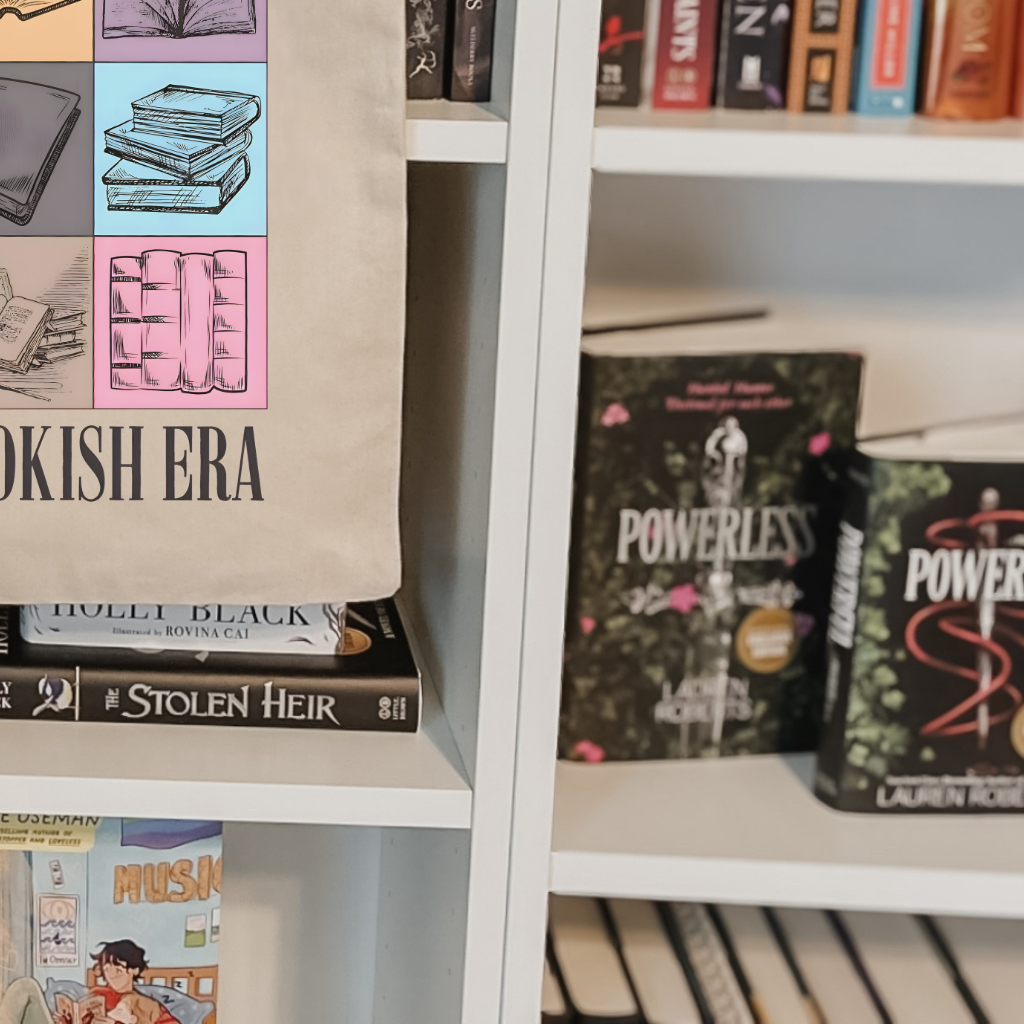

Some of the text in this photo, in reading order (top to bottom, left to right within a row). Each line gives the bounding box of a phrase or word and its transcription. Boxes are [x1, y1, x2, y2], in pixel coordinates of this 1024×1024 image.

[162, 425, 265, 502] ERA
[615, 504, 818, 564] POWERLESS
[190, 604, 310, 626] BLACK
[165, 626, 219, 638] ROVINA
[223, 628, 249, 639] CAI
[105, 681, 340, 725] THE STOLEN HEIR
[17, 813, 100, 826] OSEMAN
